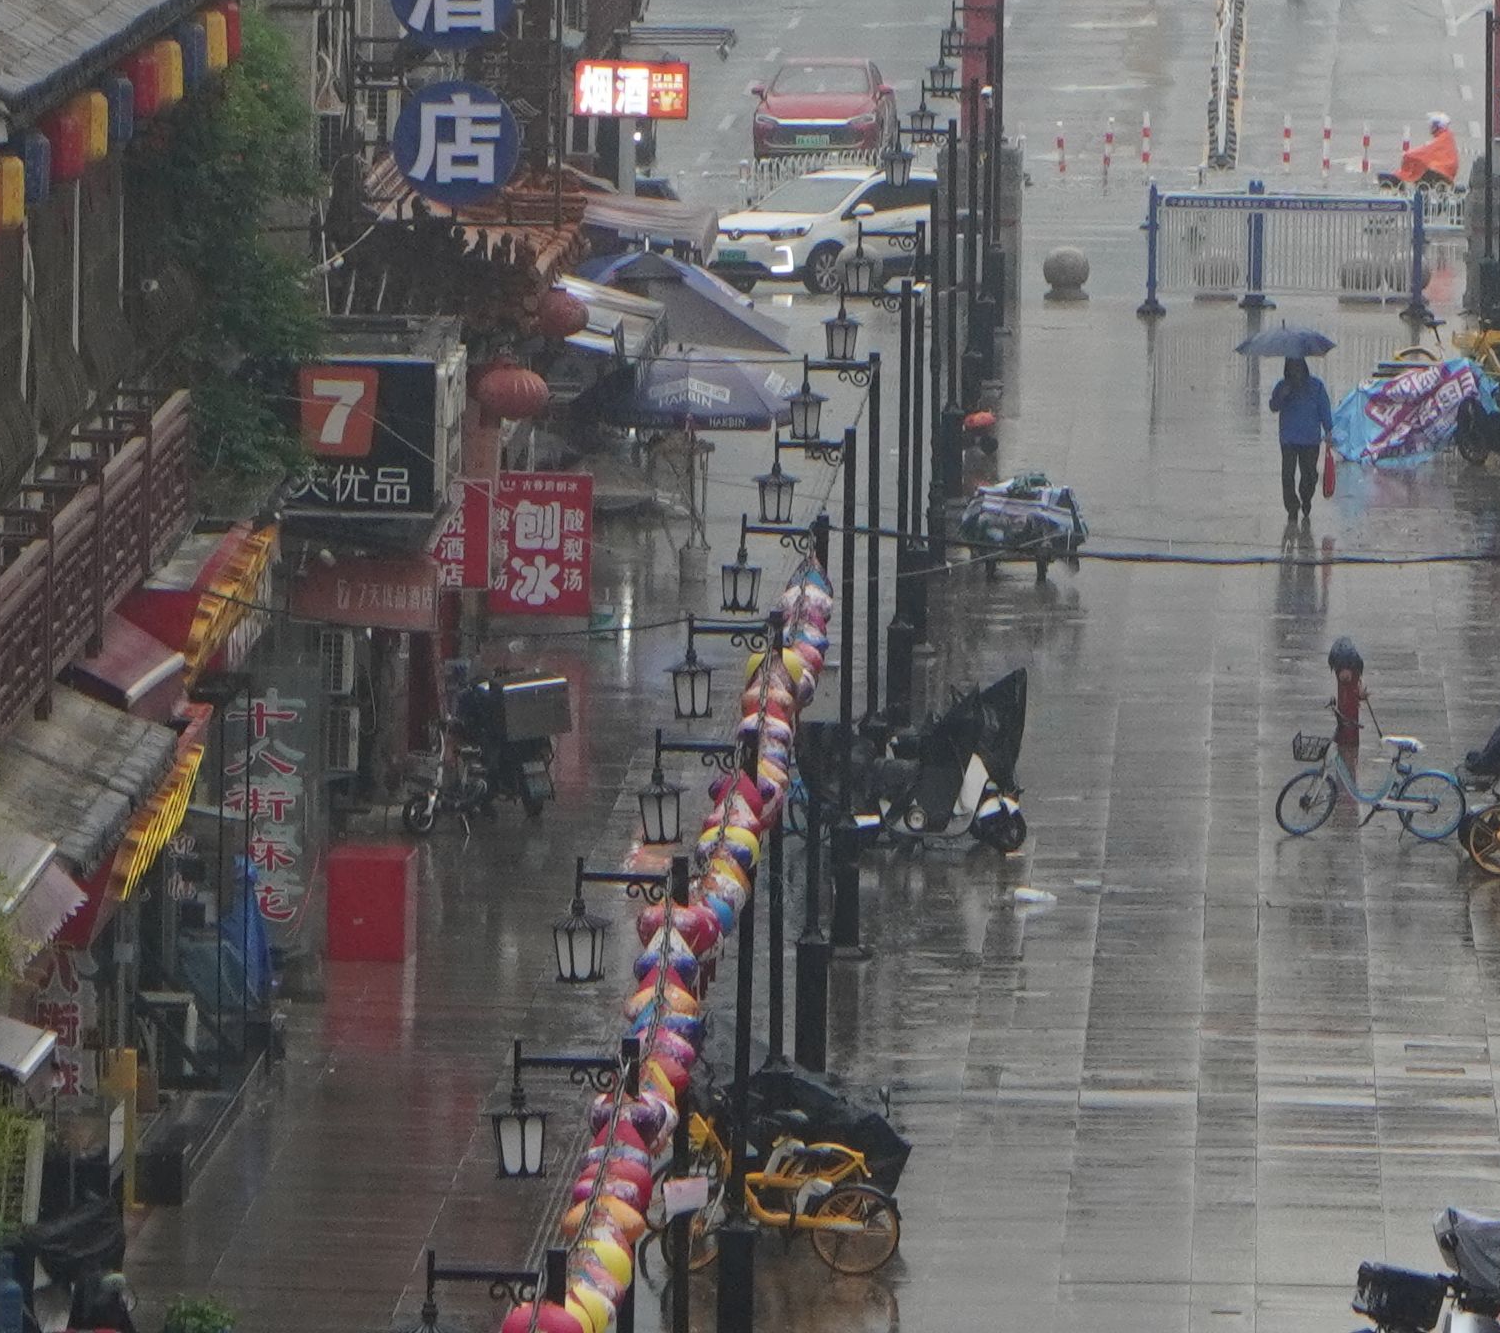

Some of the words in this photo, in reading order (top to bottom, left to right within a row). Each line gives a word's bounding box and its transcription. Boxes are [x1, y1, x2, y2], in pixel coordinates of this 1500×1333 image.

[580, 64, 649, 114] 烟酒
[311, 379, 366, 446] 7
[510, 499, 561, 606] 刨冰
[563, 508, 585, 591] 酸梨汤
